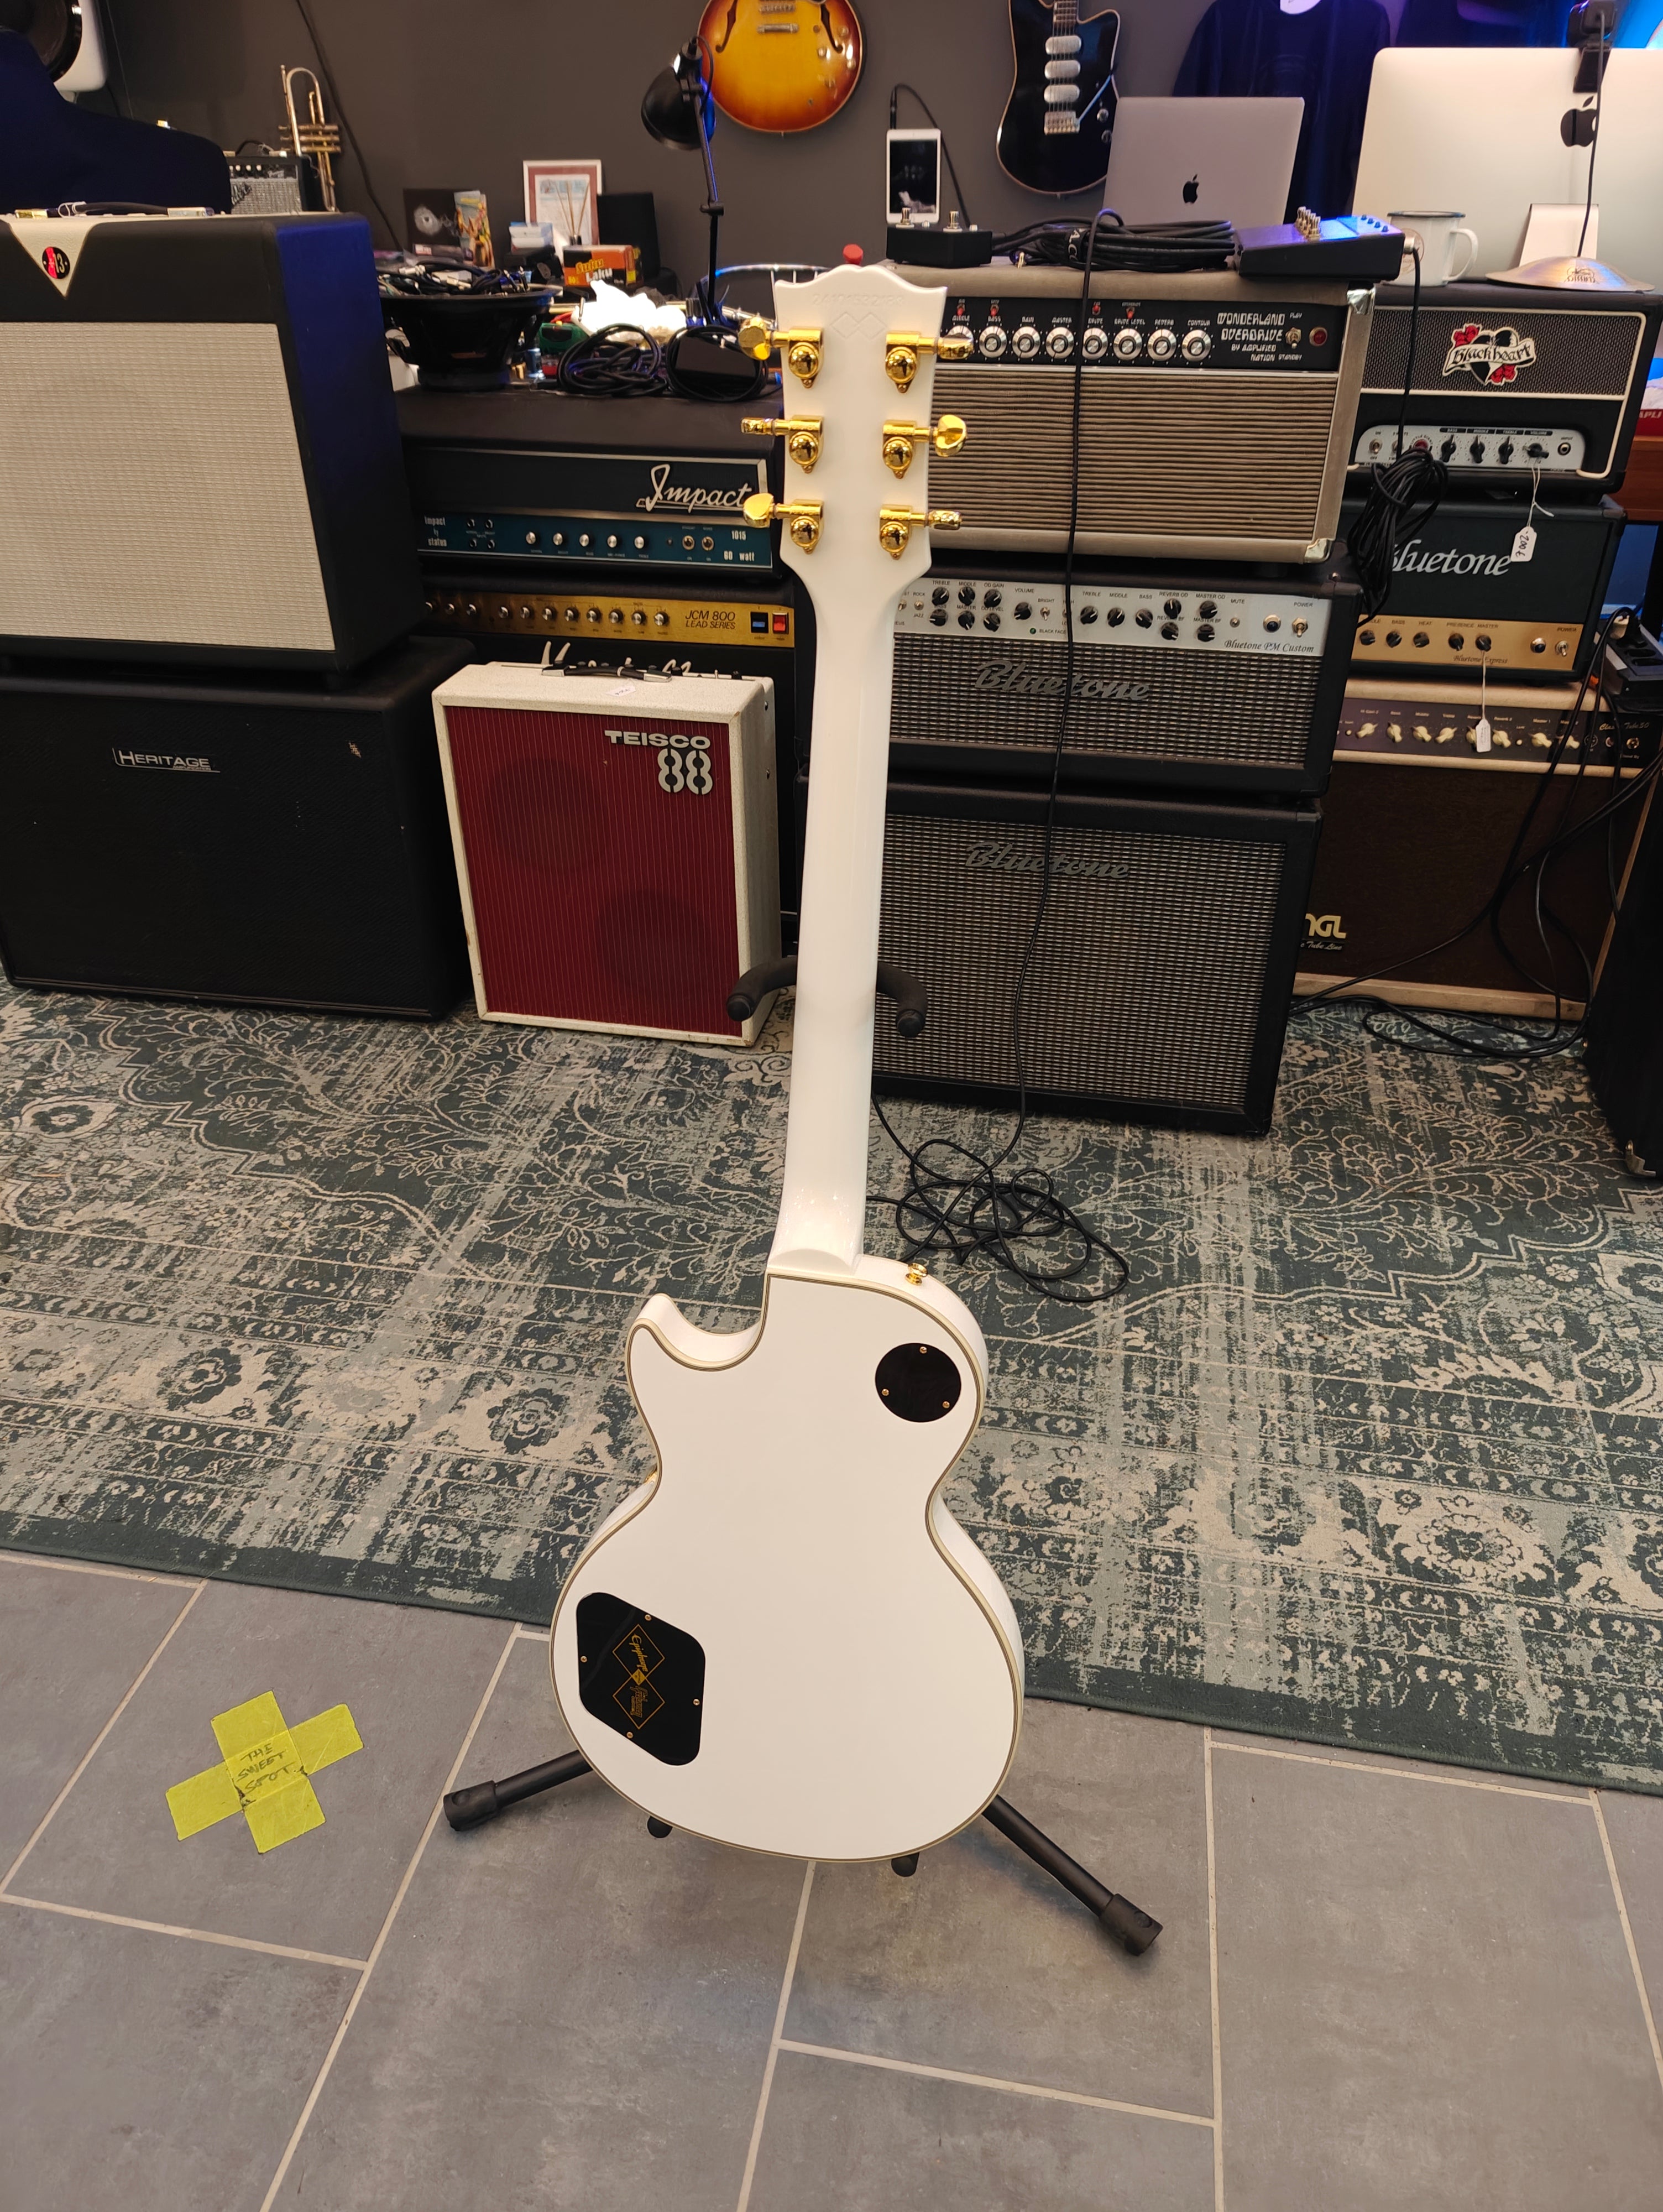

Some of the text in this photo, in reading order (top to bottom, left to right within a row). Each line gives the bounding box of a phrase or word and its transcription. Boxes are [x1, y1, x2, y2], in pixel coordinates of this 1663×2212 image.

[1217, 312, 1285, 325] WONDERLAND
[1221, 328, 1284, 341] OVERDRIVE
[1242, 344, 1277, 352] AMPLIFIED
[637, 463, 752, 513] Impact
[428, 538, 447, 547] status
[731, 530, 746, 540] 1015
[724, 551, 755, 562] 60 watt
[1393, 539, 1514, 576] luetone
[685, 610, 735, 621] JCM 800
[710, 621, 735, 629] SERIES
[1224, 639, 1314, 653] Bluetone PM Custom
[1453, 654, 1508, 664] Bluetone Express
[974, 660, 1150, 701] Bluetone
[604, 730, 710, 749] TEISCO
[118, 749, 211, 768] HERITAGE
[657, 748, 713, 795] 88
[965, 840, 1129, 878] Bluetone
[1305, 913, 1347, 939] NGL
[1306, 941, 1324, 949] Tube
[629, 1634, 649, 1672] Epiphone
[240, 1743, 275, 1761] THE
[235, 1750, 286, 1782] SWEET
